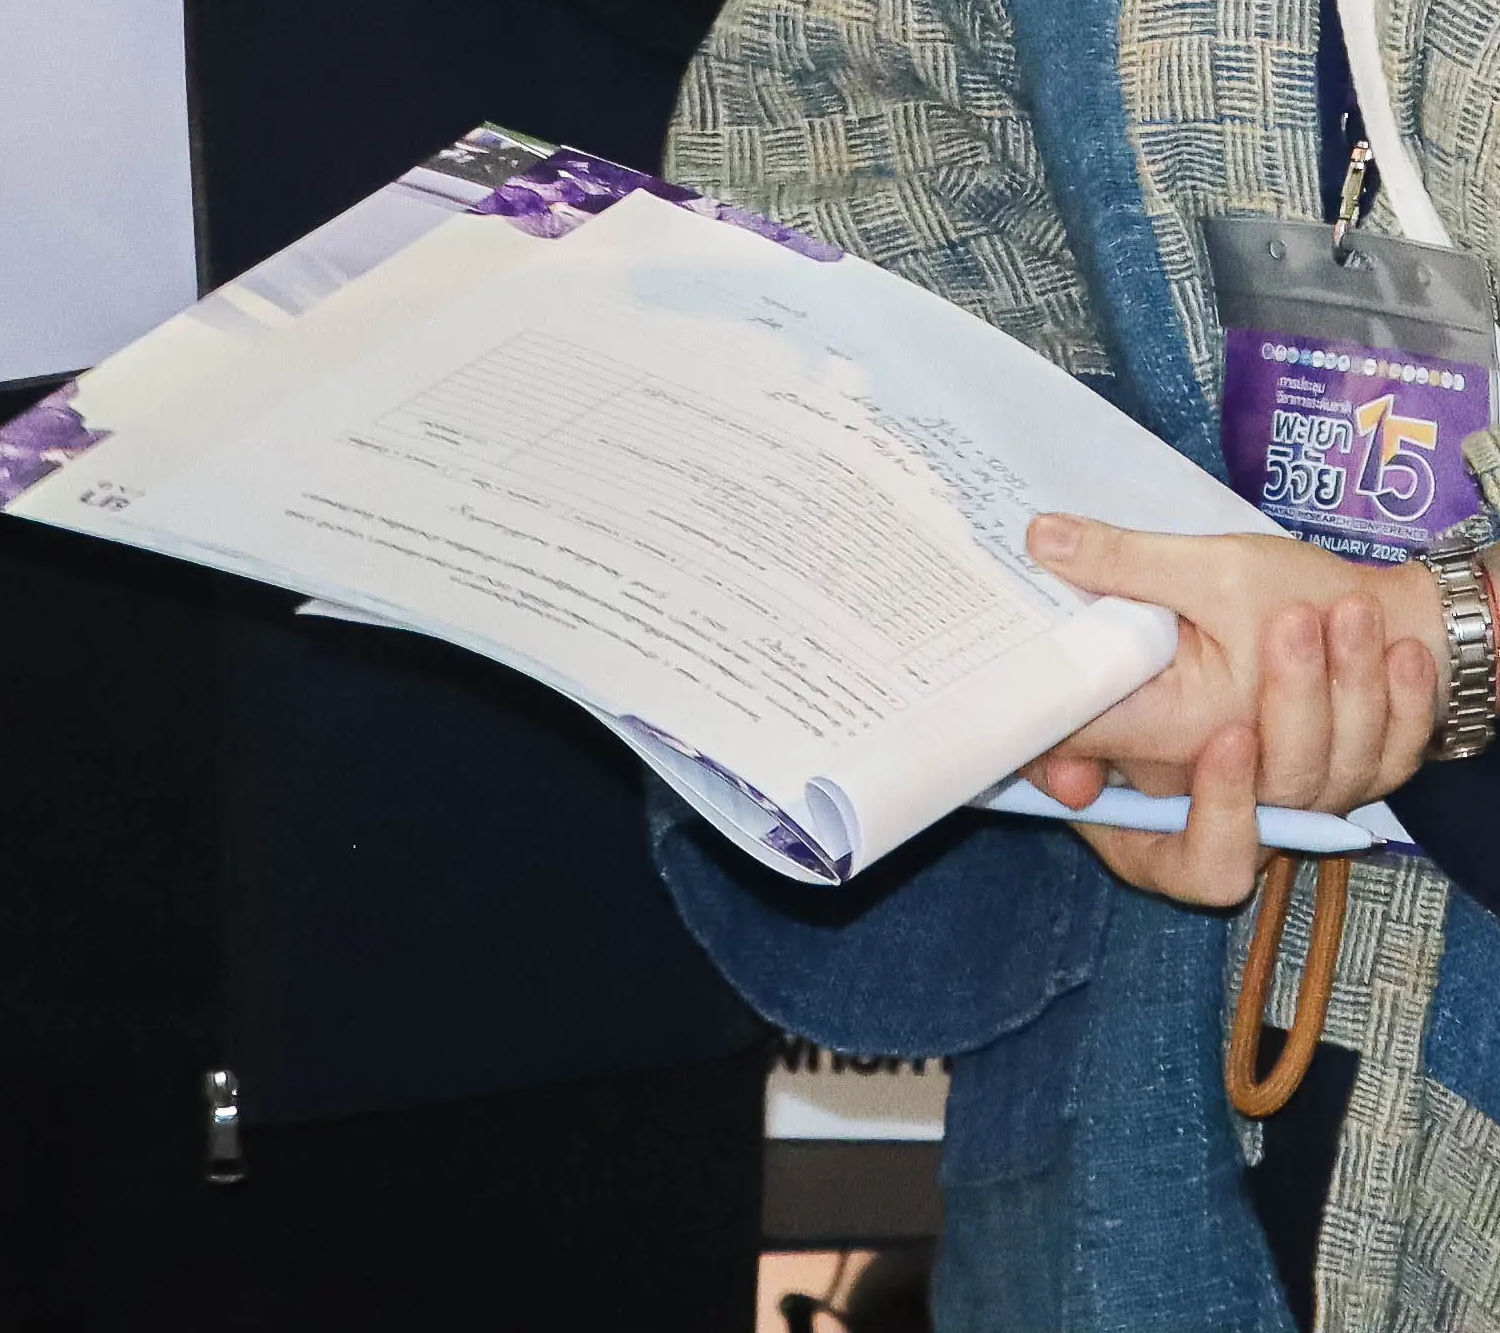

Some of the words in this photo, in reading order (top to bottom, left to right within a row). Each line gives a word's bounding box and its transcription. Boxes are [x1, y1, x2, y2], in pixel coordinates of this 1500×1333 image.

[1272, 409, 1354, 455] พะเยา
[1355, 393, 1439, 522] 15
[1262, 444, 1347, 511] วิจัย
[1371, 544, 1409, 563] 2026
